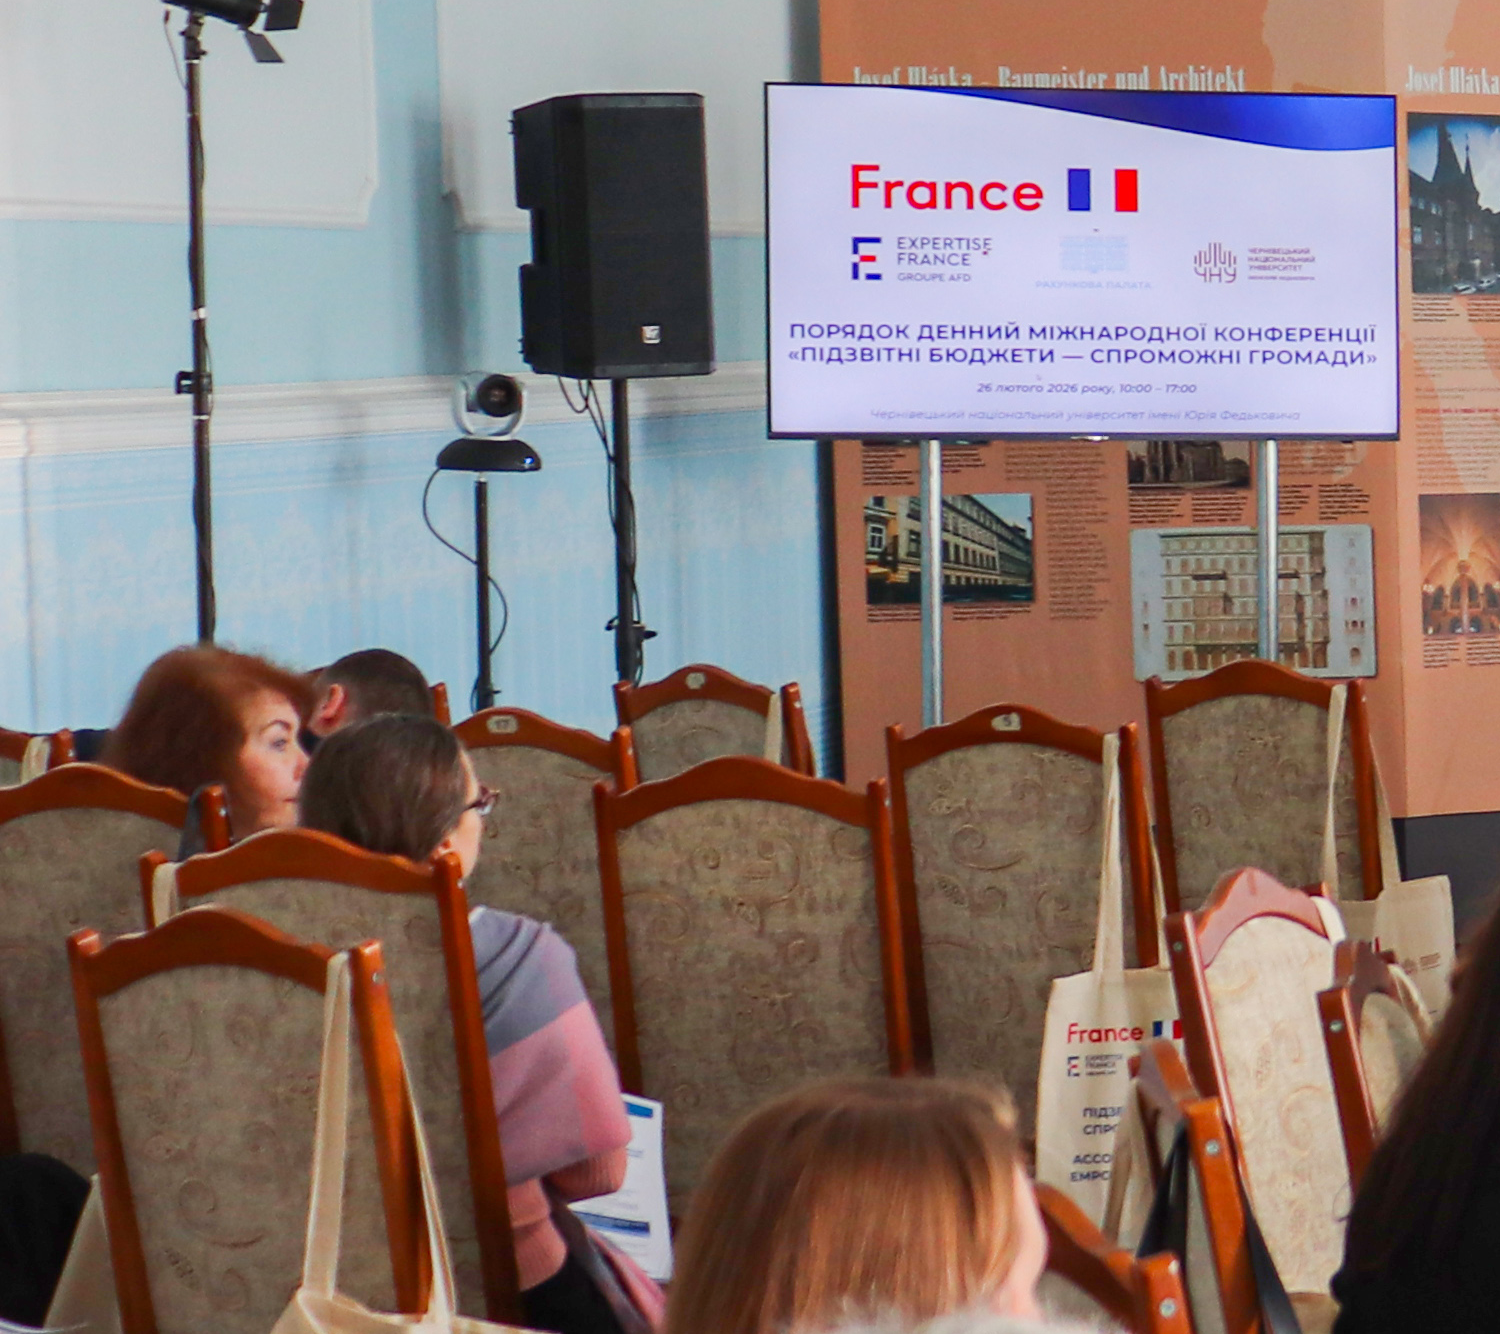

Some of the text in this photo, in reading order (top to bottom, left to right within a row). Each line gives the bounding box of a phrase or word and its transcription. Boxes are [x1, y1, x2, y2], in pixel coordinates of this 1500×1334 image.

[1405, 65, 1446, 92] Josef
[851, 164, 1043, 211] France
[897, 237, 993, 252] EXPERTISE
[897, 253, 970, 267] FRANCE
[897, 272, 972, 282] GROUPE AFD
[790, 322, 1377, 344] ПОРЯДОК ДЕННИЙ МІЖНАРОДНОЇ КОНФЕРЕНЦІЇ
[788, 347, 1377, 367] «ПІДЗВІТНІ БЮДЖЕТИ СПРОМОЖНІ ГРОМАДИ»
[977, 383, 1197, 395] 26 лютого 2026 року, 10:00 17:00
[1067, 1023, 1144, 1043] France
